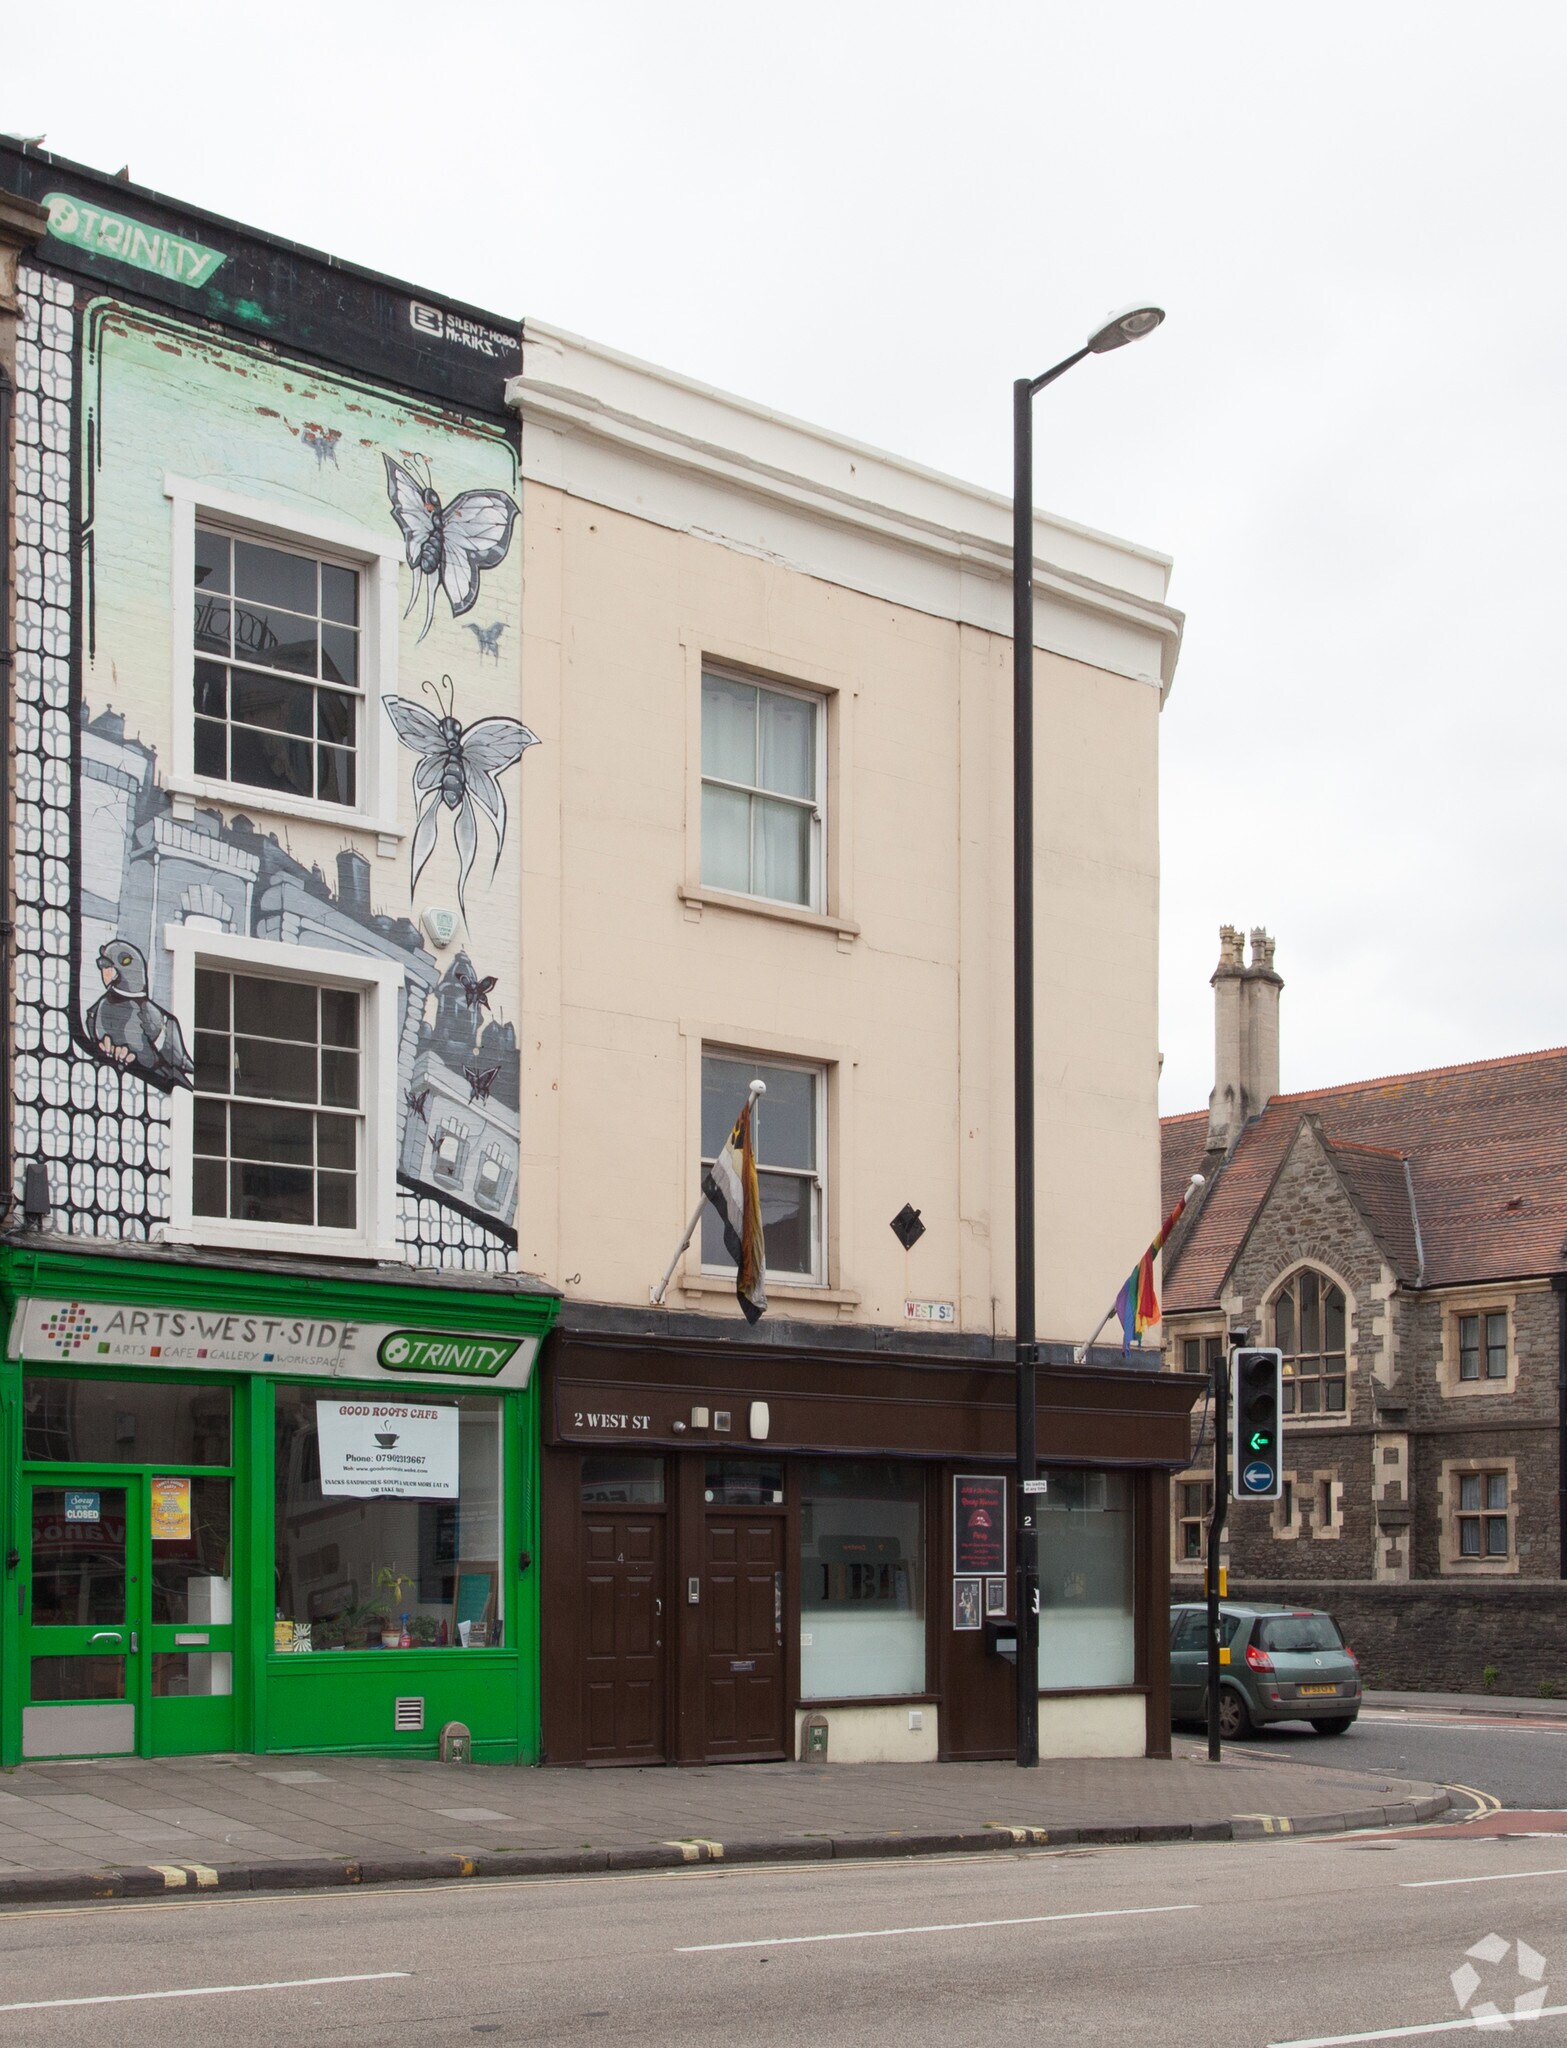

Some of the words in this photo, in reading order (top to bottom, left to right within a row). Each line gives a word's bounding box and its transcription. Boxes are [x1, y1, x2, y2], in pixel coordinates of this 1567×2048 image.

[80, 208, 212, 280] TRINITY
[906, 1302, 934, 1318] WEST
[939, 1305, 951, 1319] ST
[113, 1344, 146, 1356] ARTS
[163, 1346, 195, 1358] CAFE
[210, 1349, 260, 1361] GALLERY
[276, 1354, 346, 1368] WORKSPACE
[408, 1341, 508, 1370] TRINITY
[339, 1406, 370, 1416] GOOD
[372, 1407, 408, 1418] ROOTS
[410, 1408, 439, 1420] CAFE
[574, 1412, 583, 1427] 2
[587, 1413, 629, 1429] WEST
[632, 1415, 651, 1430] ST
[346, 1454, 374, 1463] Phone:
[70, 1494, 94, 1507] Sorry
[66, 1509, 99, 1519] CLOSED
[1024, 1515, 1032, 1526] 2
[617, 1552, 625, 1565] 4
